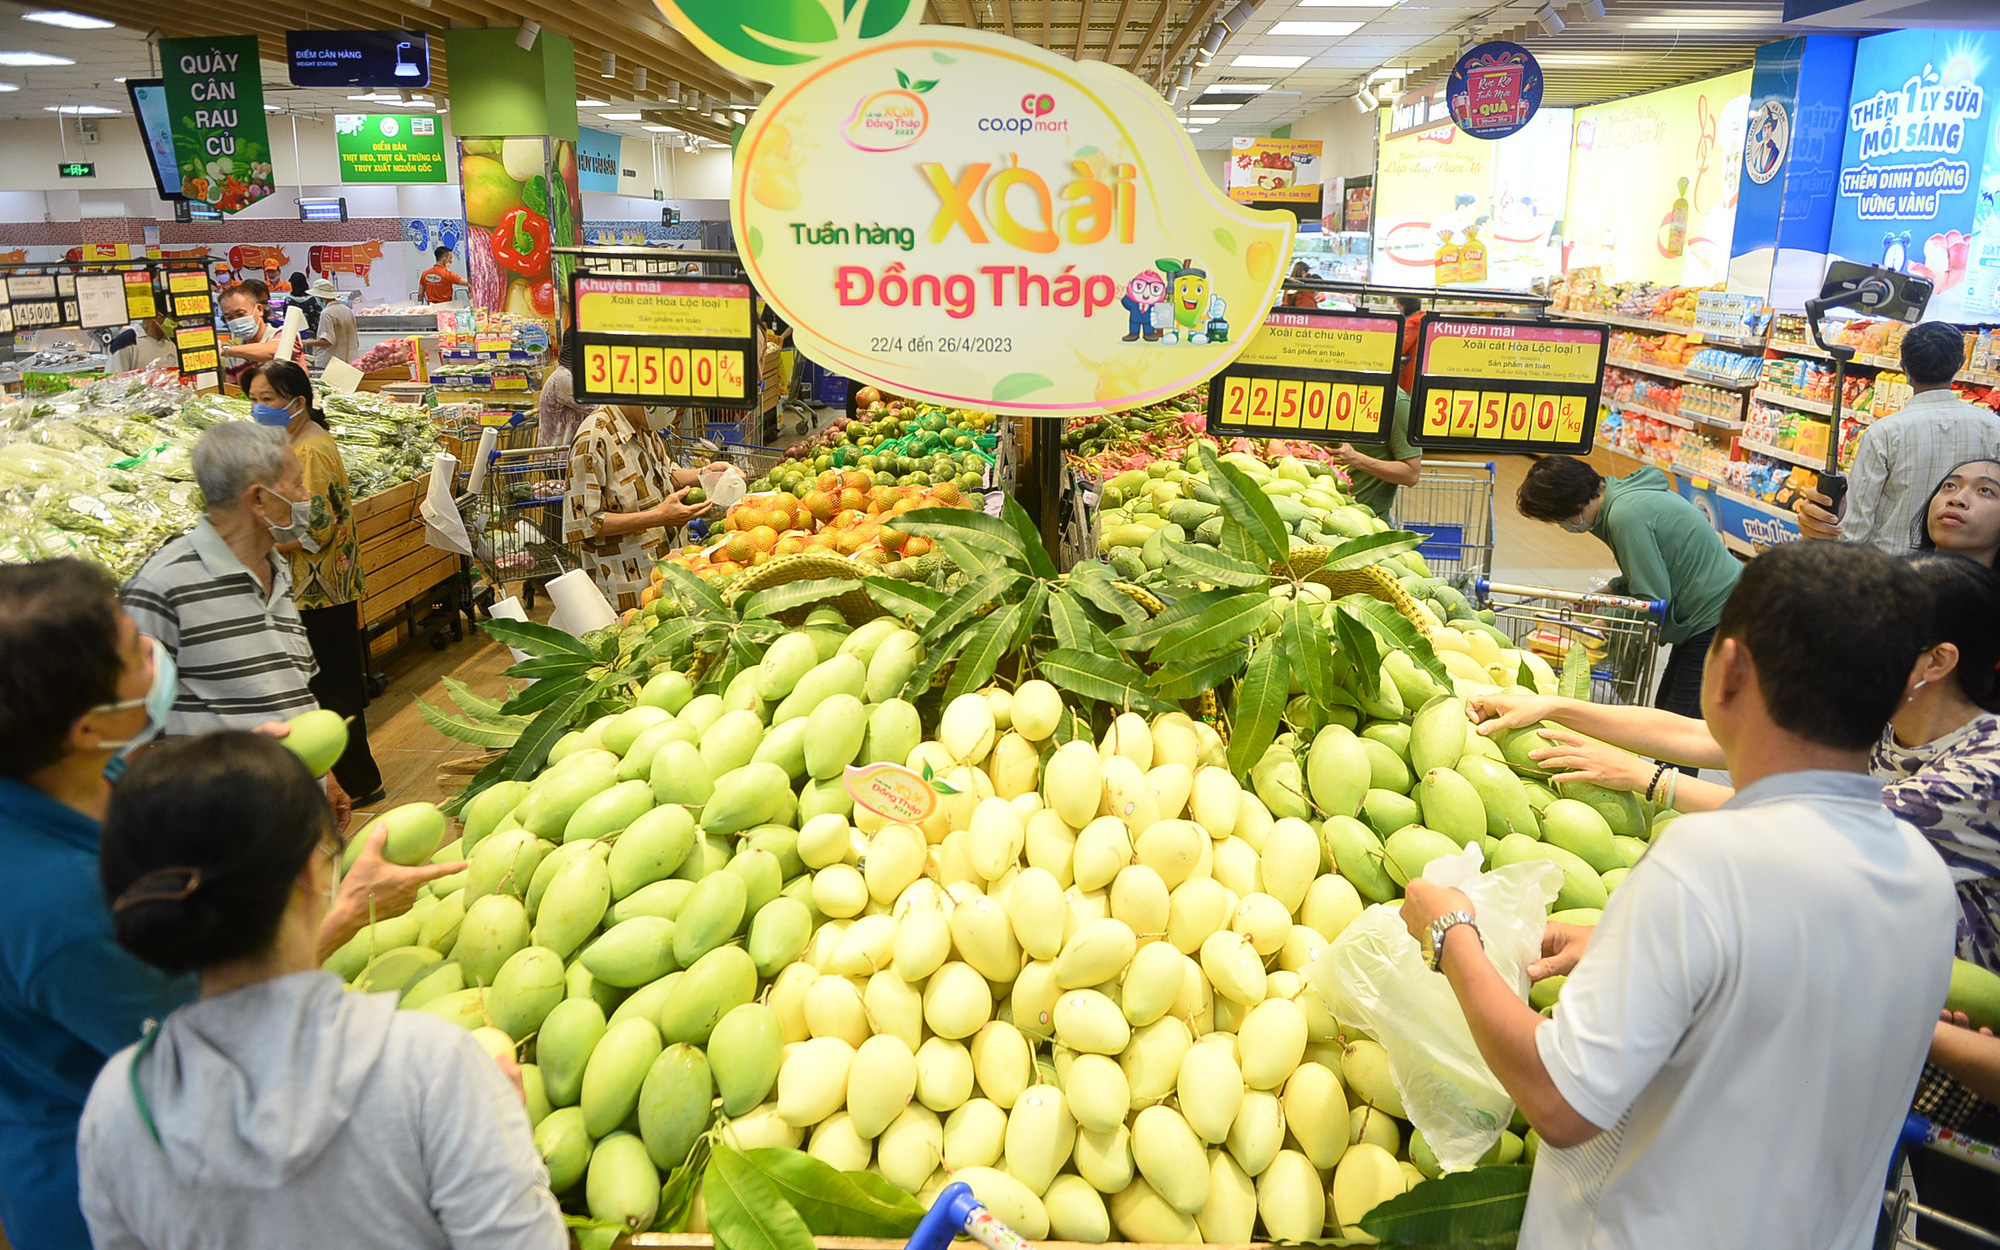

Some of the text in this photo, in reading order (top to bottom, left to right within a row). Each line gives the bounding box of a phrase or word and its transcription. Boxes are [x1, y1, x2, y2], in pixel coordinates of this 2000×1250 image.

[180, 47, 239, 74] QUẦY
[295, 48, 362, 59] ĐIỂM CÂN HÀNG
[190, 78, 236, 101] CÂN
[1854, 80, 1980, 126] THÊM 1 LY SỮA
[195, 109, 238, 128] RAU
[865, 117, 921, 131] Đồng Tháp
[206, 131, 236, 156] CỦ
[1863, 117, 1900, 155] MỖI
[1905, 116, 1961, 149] SÁNG
[372, 140, 407, 151] ĐIỂM BÁN
[359, 153, 376, 162] HEO,
[432, 152, 442, 162] GÀ
[353, 164, 372, 173] TRUY
[373, 162, 392, 172] XUẤT
[418, 162, 433, 173] GỐC
[1844, 167, 1964, 191] THÊM DINH DƯỠNG
[1861, 191, 1935, 213] VỮNG VÀNG
[790, 219, 915, 251] Tuần hàng
[834, 262, 1116, 319] Đồng Tháp
[610, 294, 729, 310] Xoài cát Hòa Lộc loại 1
[870, 334, 1013, 353] 22/4 đến 26/4/2023
[1269, 326, 1363, 344] Xoài cát chu vàng
[1282, 347, 1297, 355] Sản
[1297, 347, 1318, 357] phẩm
[1329, 349, 1345, 358] toàn
[1462, 339, 1581, 356] Xoài cát Hòa Lộc loại 1
[591, 353, 712, 387] 37.500
[1487, 359, 1502, 367] Sản
[1502, 360, 1523, 370] phẩm
[1535, 361, 1551, 370] toàn
[1229, 385, 1352, 421] 22.500
[1431, 396, 1554, 431] 37.500
[1745, 520, 1769, 538] THÊM
